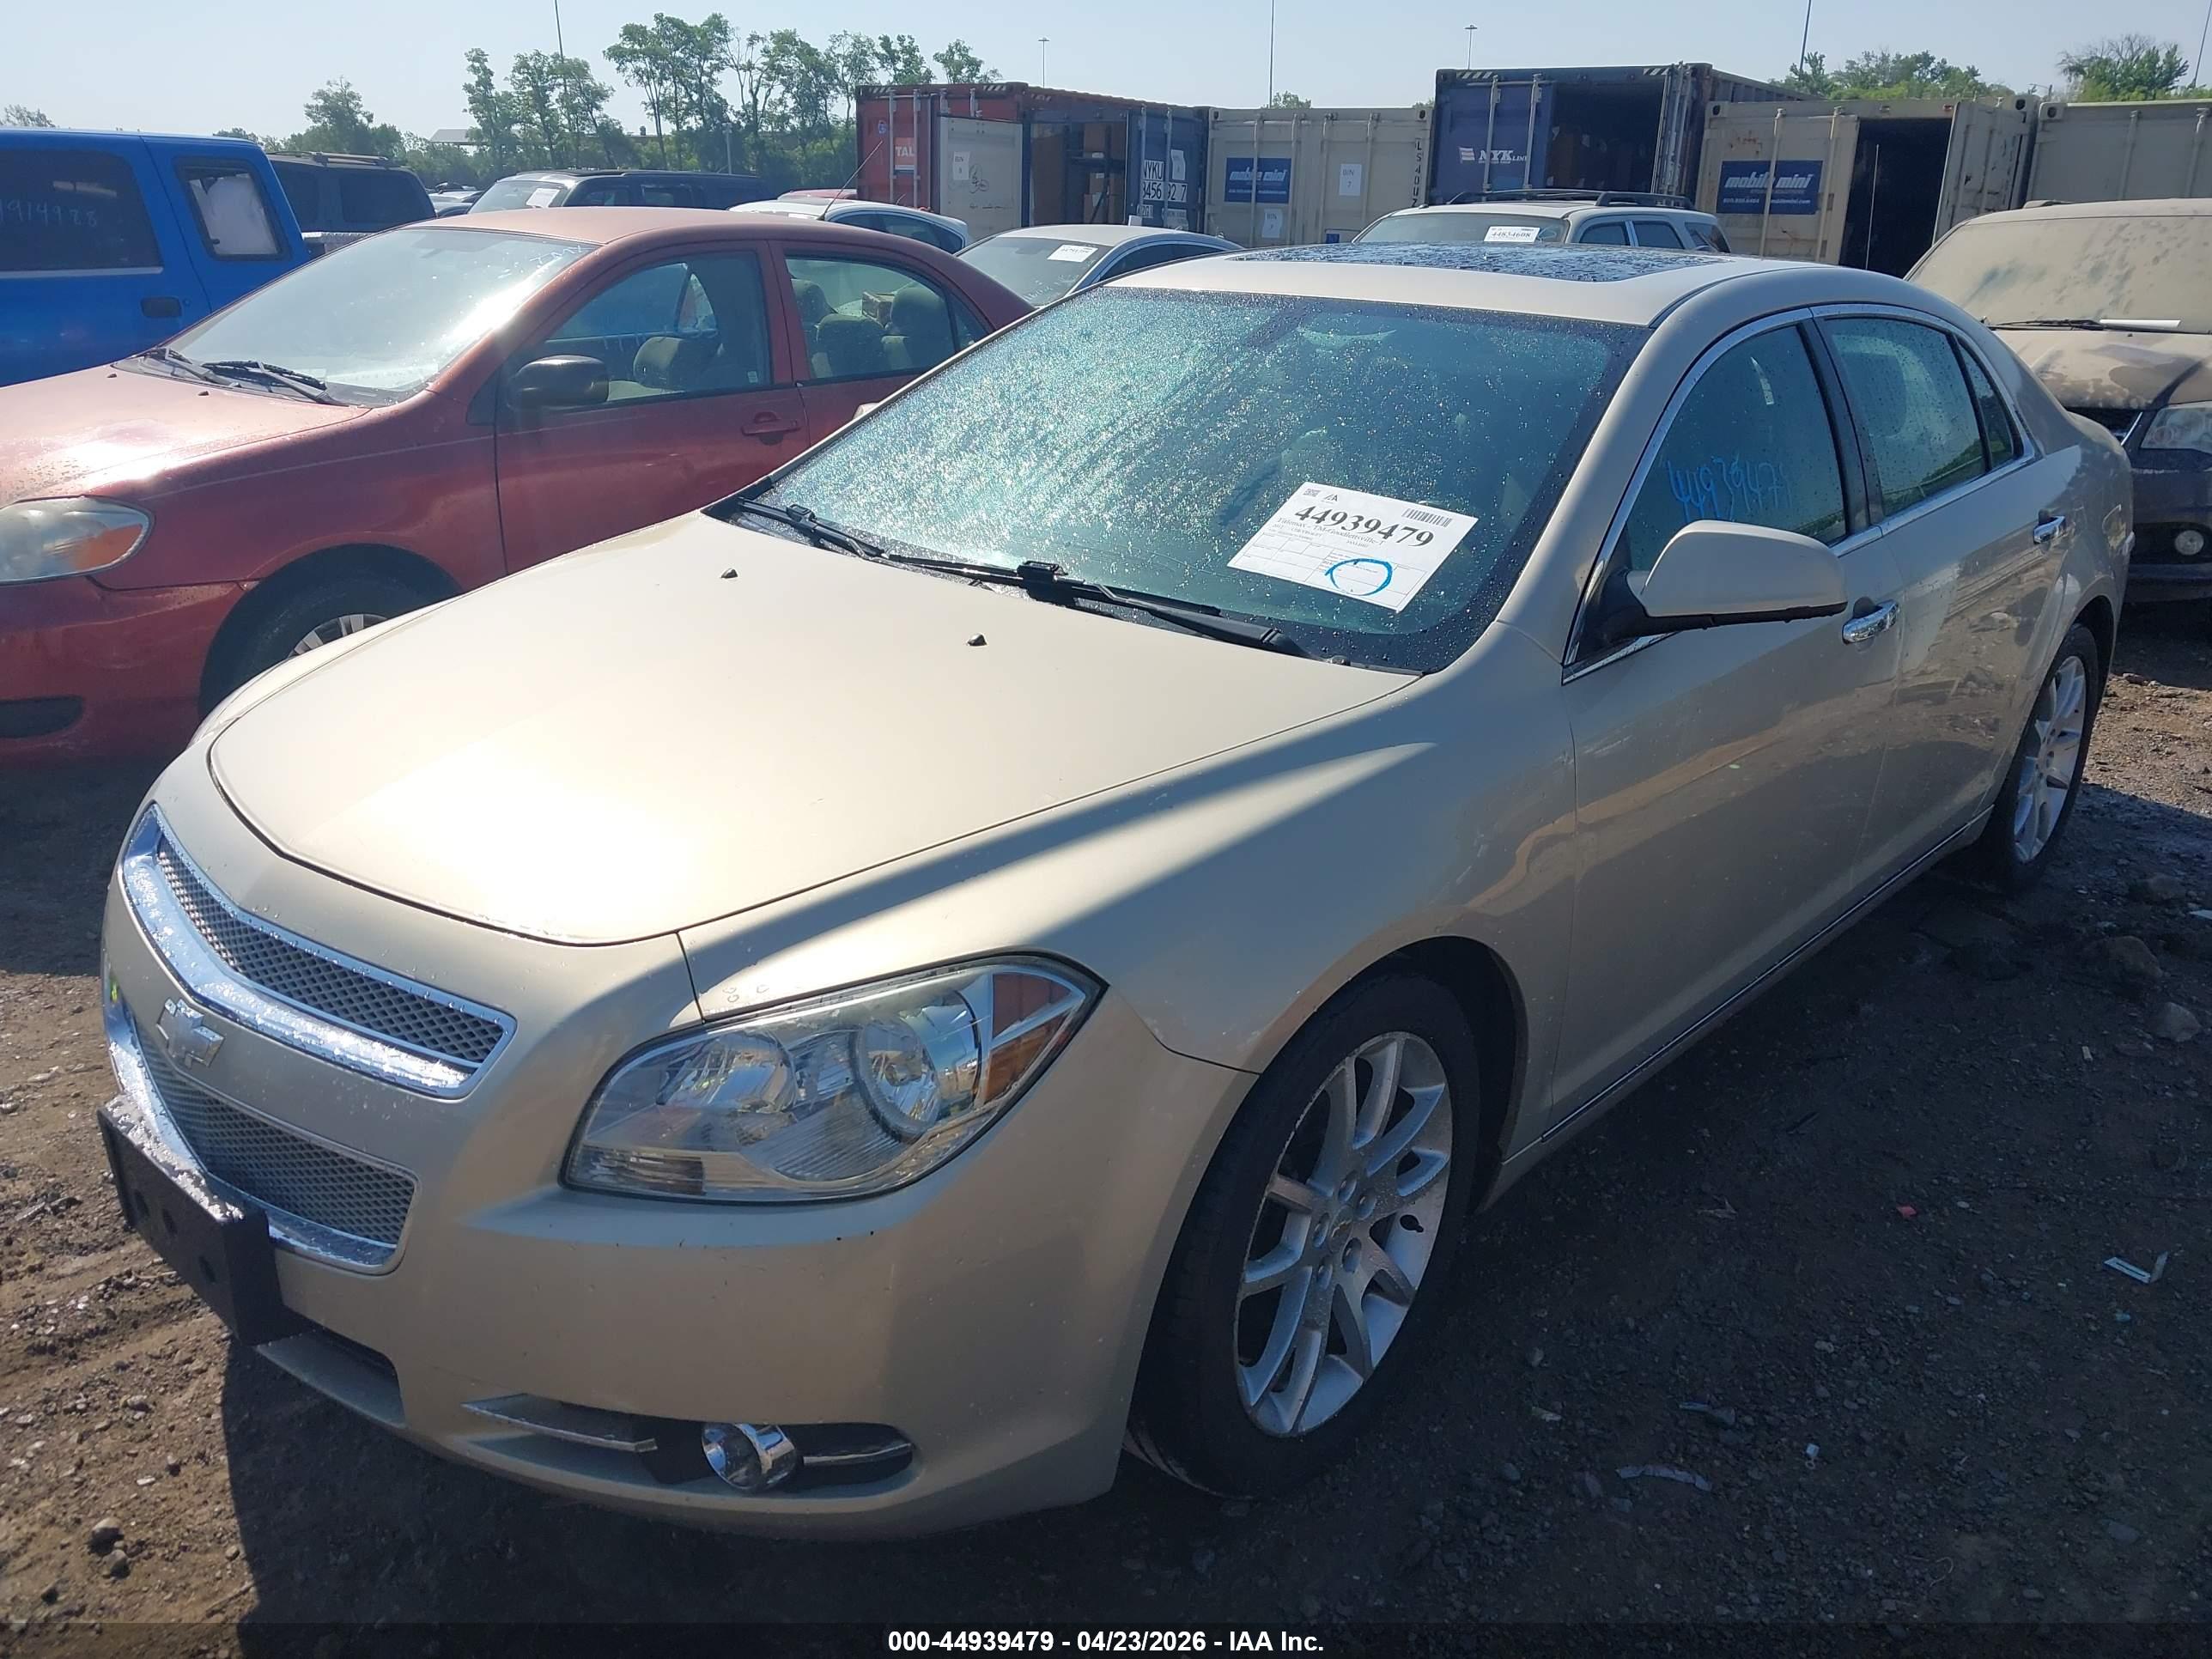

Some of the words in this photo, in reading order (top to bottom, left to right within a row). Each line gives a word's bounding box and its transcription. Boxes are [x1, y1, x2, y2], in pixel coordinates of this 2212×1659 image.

[895, 146, 915, 157] TAL
[1478, 149, 1513, 160] NYK
[1775, 173, 1814, 189] mini
[1295, 505, 1435, 547] 44939479
